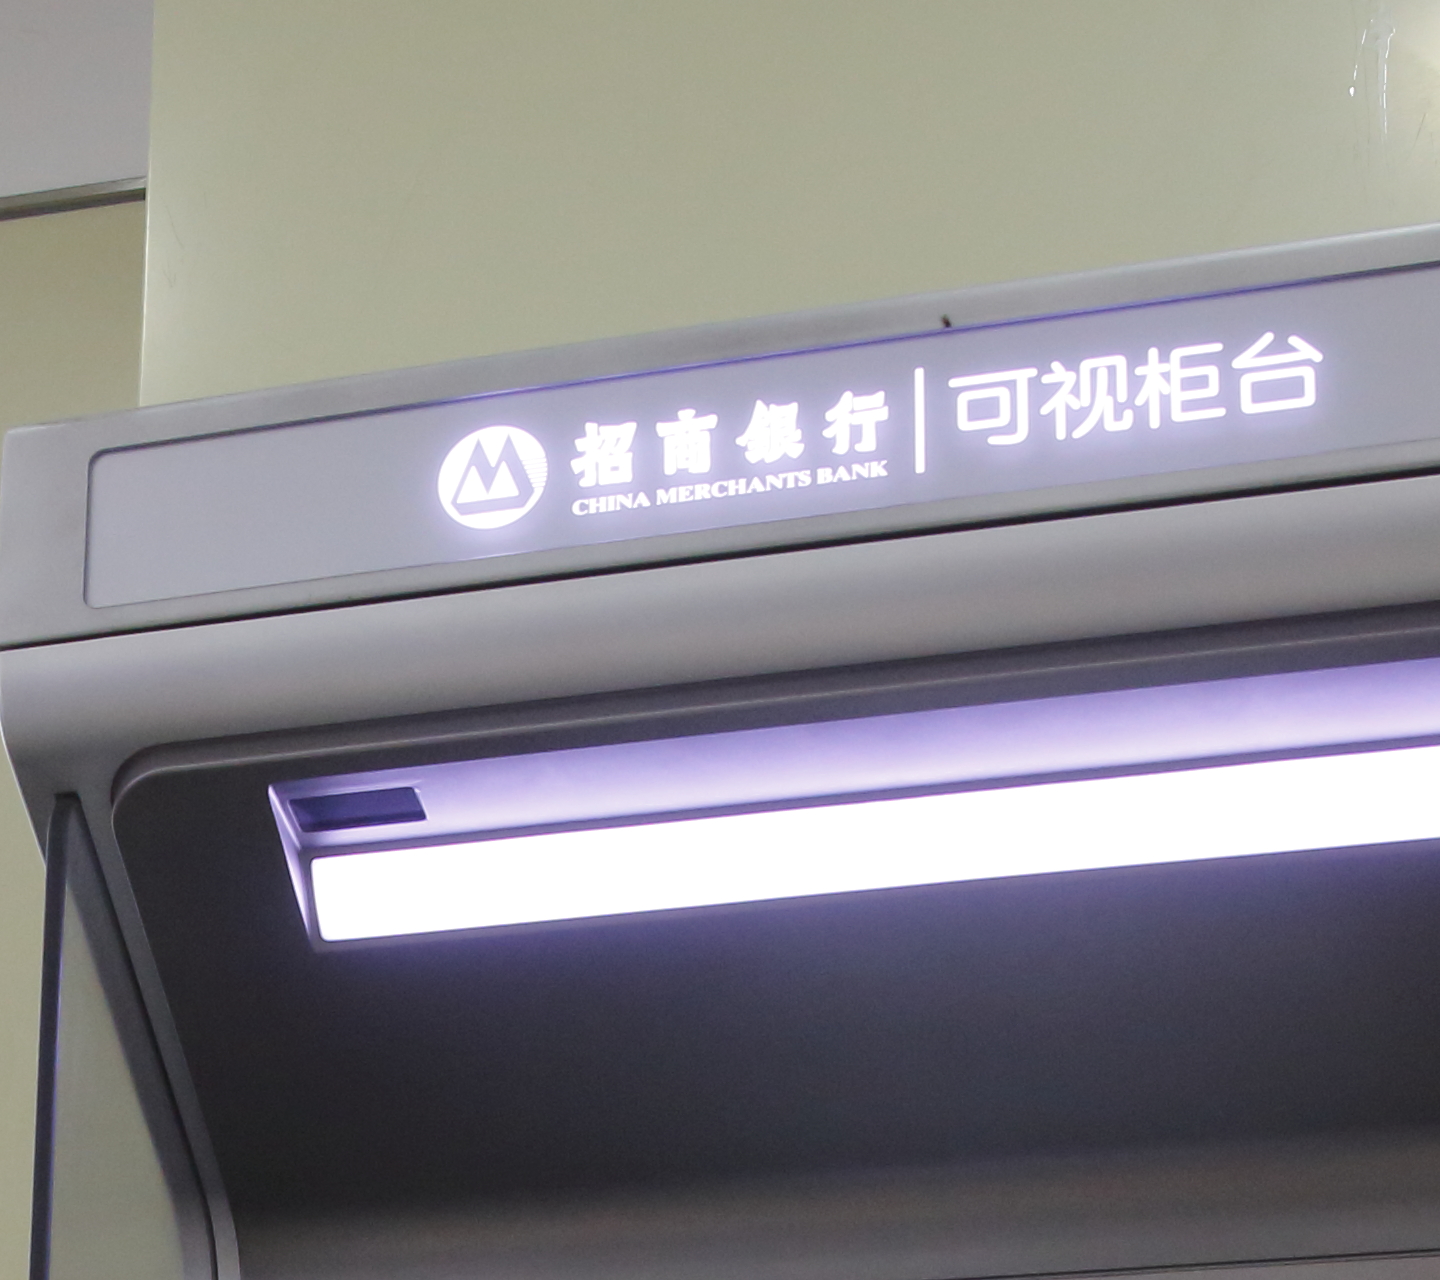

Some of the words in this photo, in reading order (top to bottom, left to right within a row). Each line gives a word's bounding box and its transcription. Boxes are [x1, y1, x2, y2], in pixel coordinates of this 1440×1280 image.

[570, 389, 891, 489] 招商银行
[948, 332, 1325, 447] 可视柜台
[571, 490, 651, 517] CHINA
[654, 470, 812, 507] MERCHANTS
[815, 459, 890, 489] BANK
